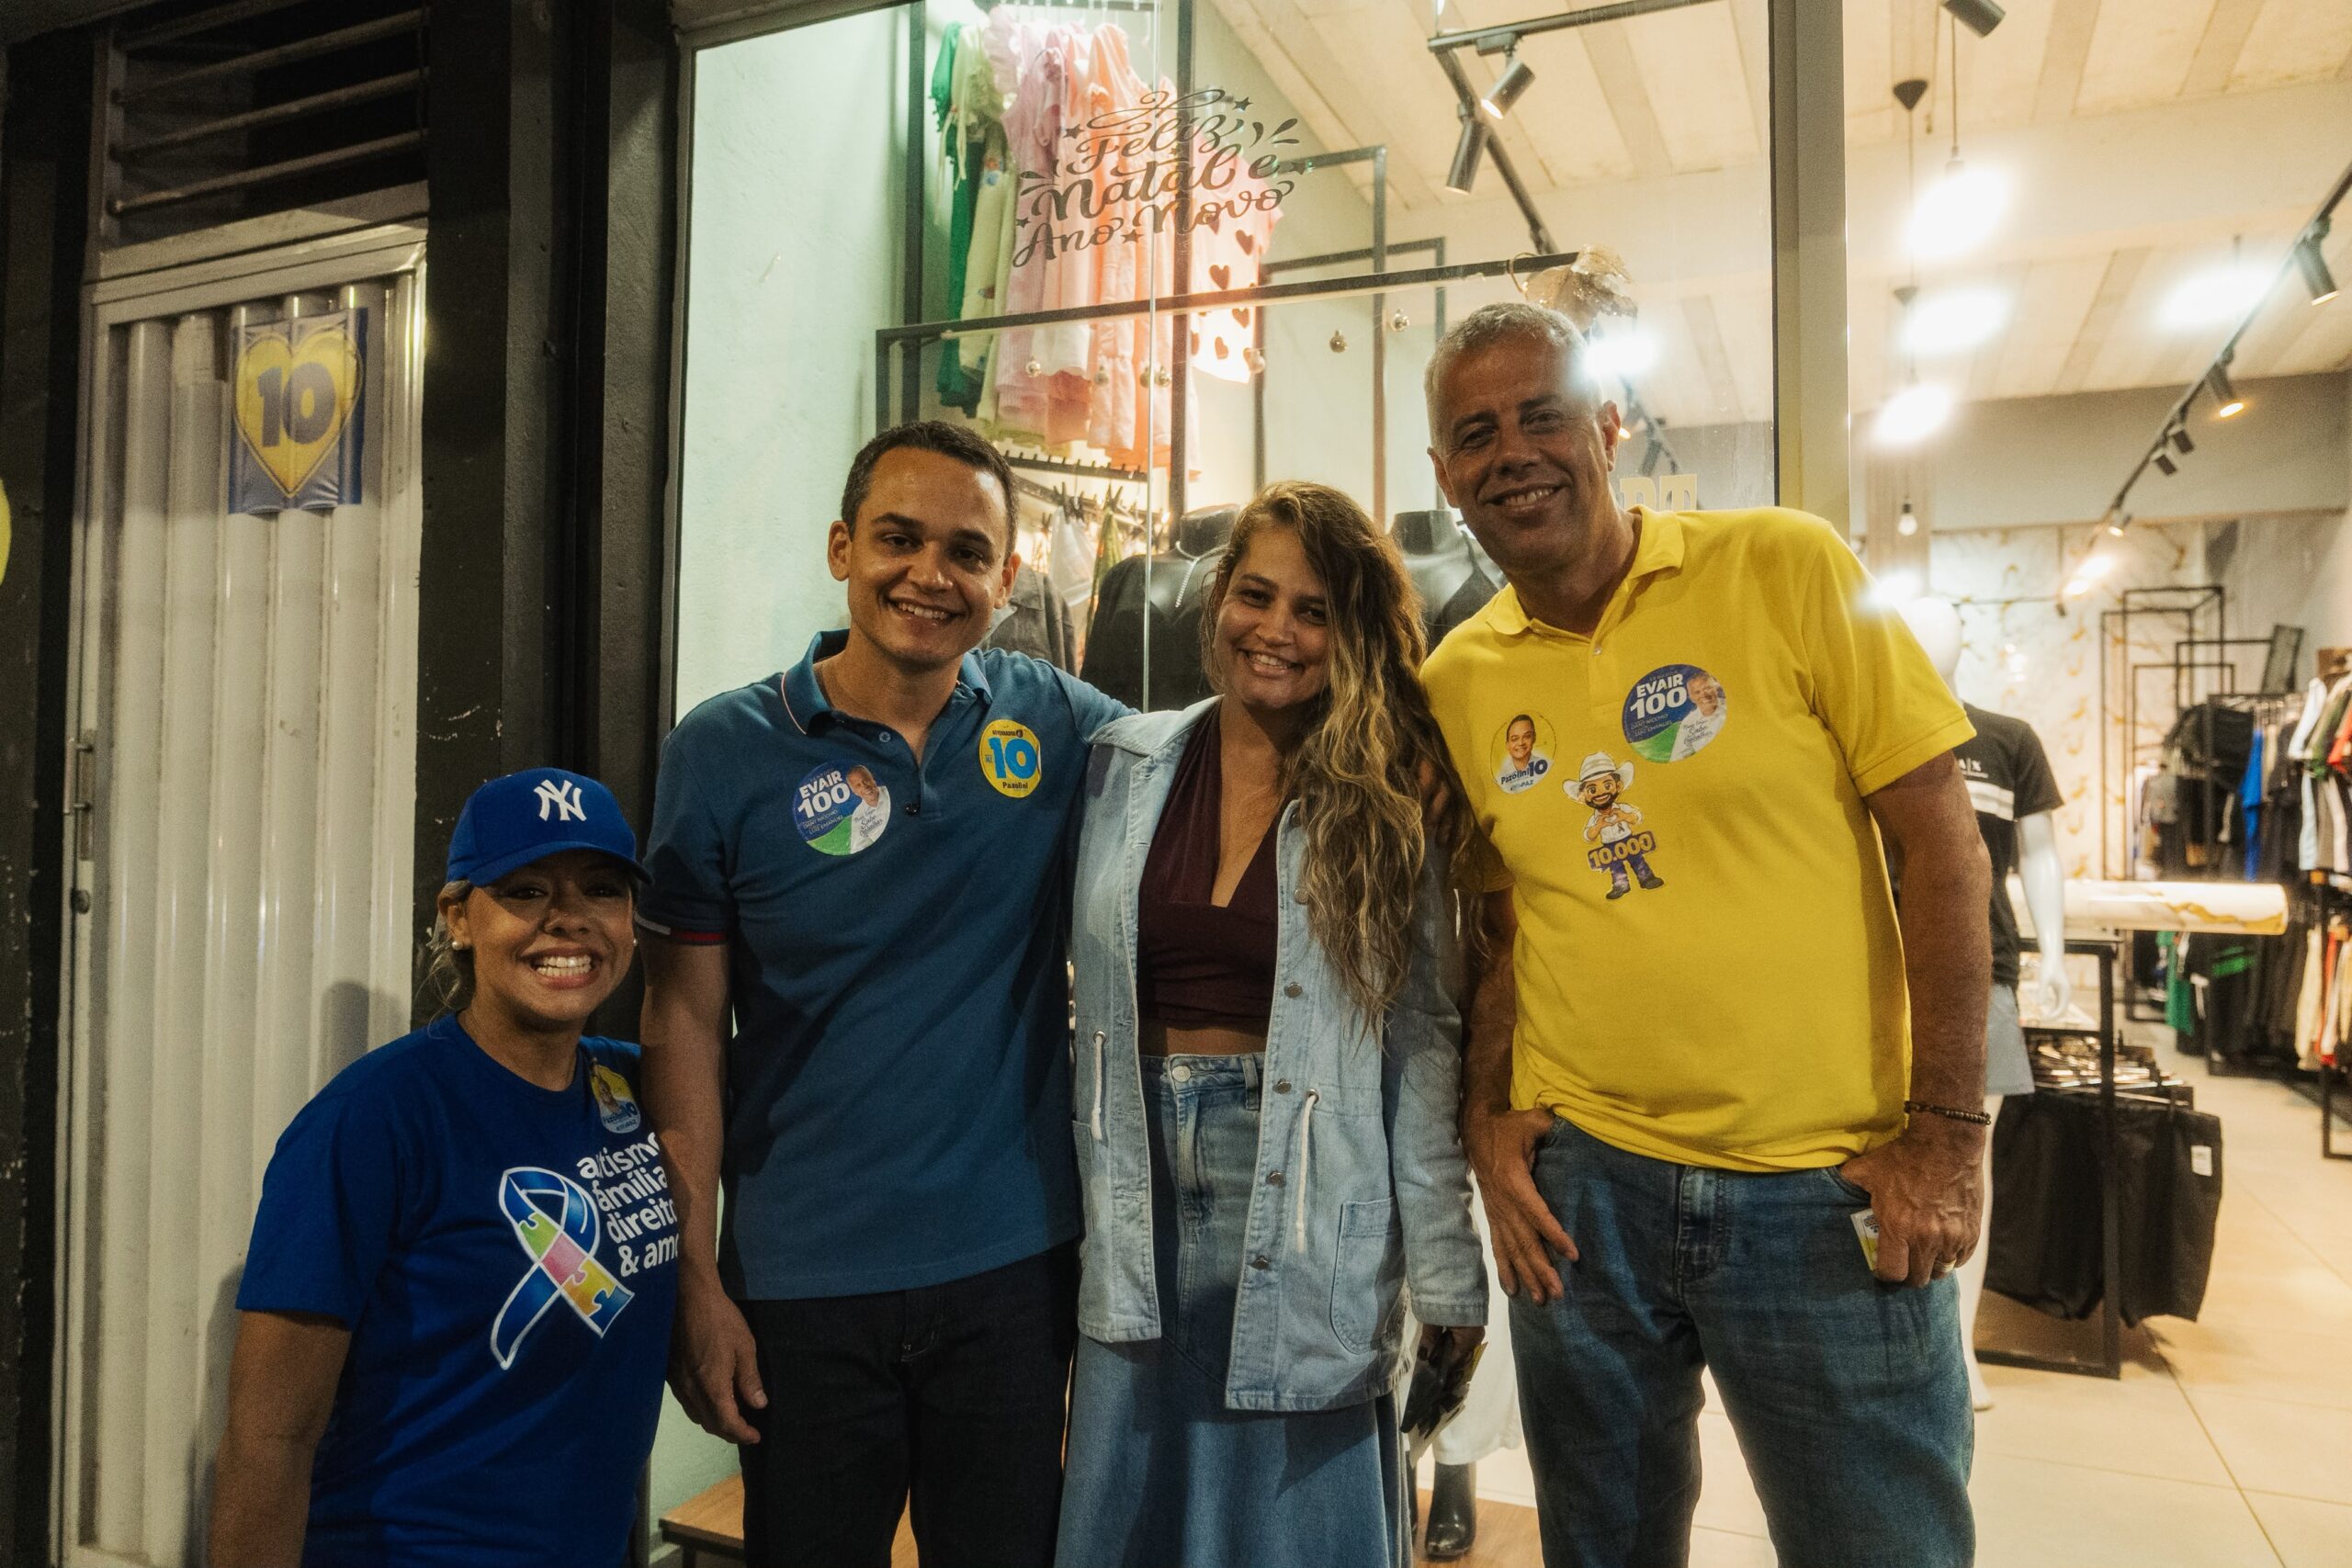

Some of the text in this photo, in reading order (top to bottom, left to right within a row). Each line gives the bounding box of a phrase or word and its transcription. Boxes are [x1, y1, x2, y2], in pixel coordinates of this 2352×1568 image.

[1066, 107, 1244, 176] Feliz
[1031, 144, 1280, 220] Natal e
[1012, 180, 1295, 267] Ano Novo
[257, 362, 336, 448] 10
[1630, 687, 1688, 719] 100
[1636, 673, 1683, 698] EVAIR
[989, 737, 1037, 779] 10
[1528, 760, 1548, 777] 10
[534, 779, 587, 821] NY
[797, 783, 850, 818] 100
[799, 771, 842, 799] EVAIR
[1589, 833, 1653, 867] 10.000
[618, 1233, 679, 1277] & am
